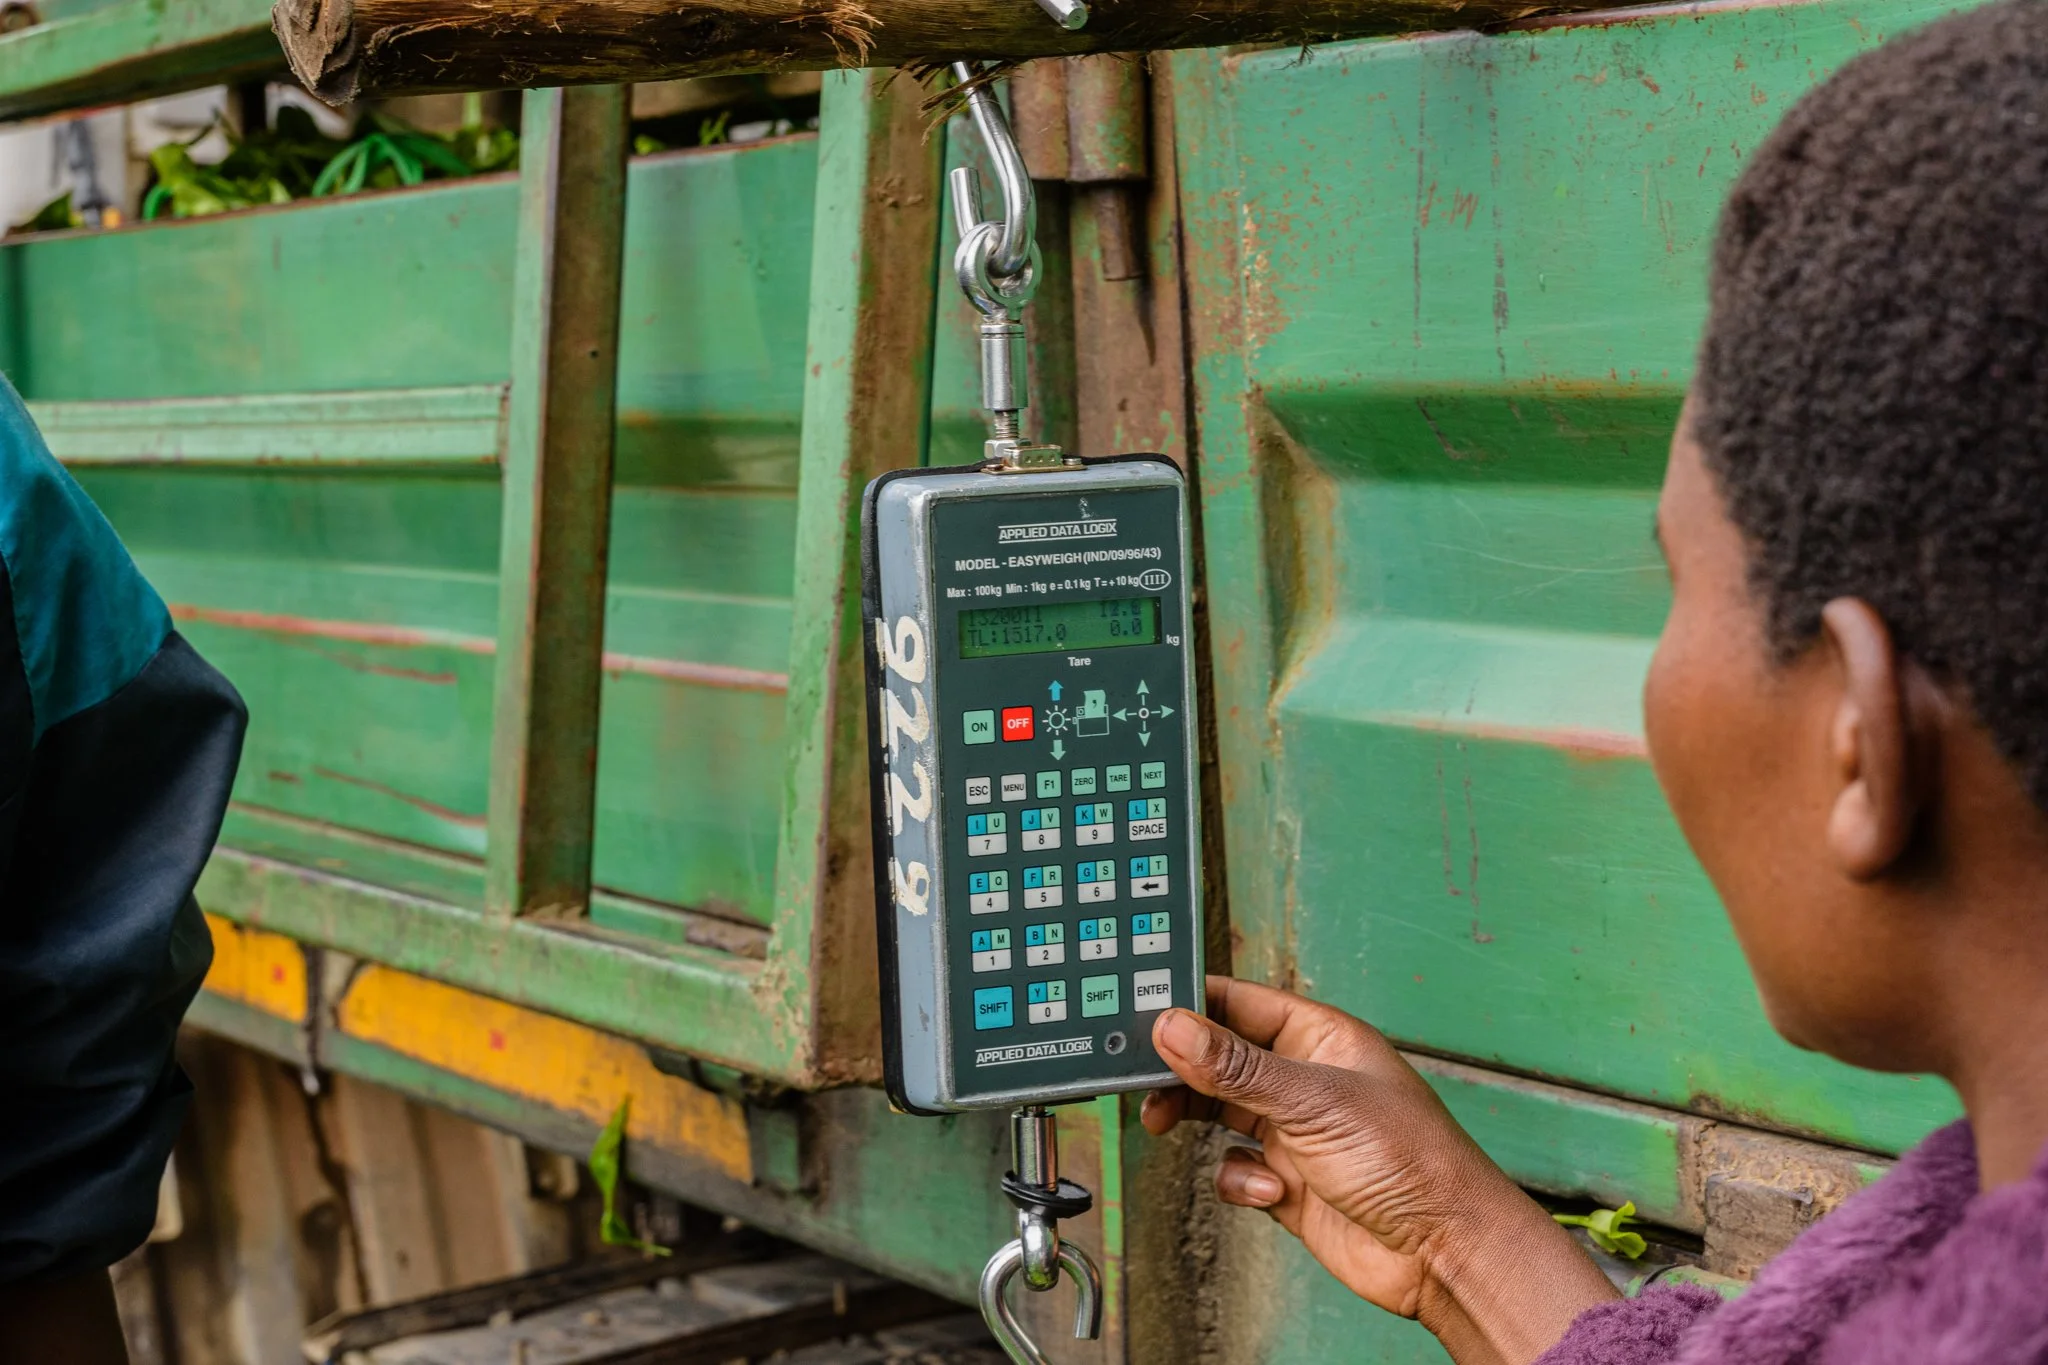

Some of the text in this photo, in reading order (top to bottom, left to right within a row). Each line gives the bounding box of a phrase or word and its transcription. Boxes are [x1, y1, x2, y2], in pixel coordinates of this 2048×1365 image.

[1000, 522, 1117, 540] APPLIED DATA LOGIX
[955, 557, 1000, 571] MODEL
[1008, 552, 1082, 568] EASYWEIGH
[975, 585, 1002, 599] 100kg
[1110, 618, 1142, 636] 0.0
[1166, 634, 1180, 646] kg
[1068, 656, 1091, 667] Tare
[971, 722, 988, 732] ON
[1007, 717, 1030, 729] OFF
[1109, 774, 1128, 783] TARE
[1144, 771, 1162, 780] NEXT
[1044, 780, 1055, 790] F1
[1074, 777, 1094, 786] ZERO
[969, 786, 988, 796] ESC
[1004, 783, 1024, 792] MENU
[1082, 808, 1108, 820] K W
[1135, 803, 1160, 815] L X
[994, 818, 1000, 828] U
[1028, 814, 1054, 825] J V
[1092, 830, 1098, 840] 9
[1132, 823, 1164, 836] SPACE
[984, 839, 990, 850] 7
[1038, 834, 1044, 845] 8
[1083, 866, 1109, 877] G S
[1137, 861, 1162, 872] H T
[976, 877, 1002, 887] E Q
[1030, 871, 1056, 882] F R
[1040, 892, 1046, 902] 5
[1094, 887, 1100, 897] 6
[986, 898, 992, 908] 4
[1085, 923, 1111, 934] C O
[1138, 918, 1164, 929] D P
[978, 934, 1005, 946] A M
[1032, 929, 1058, 940] B N
[1096, 944, 1102, 954] 3
[1043, 950, 1049, 960] 2
[990, 956, 995, 966] 1
[1034, 986, 1060, 997] Y Z
[1137, 984, 1169, 996] ENTER
[1086, 990, 1114, 1002] SHIFT
[980, 1002, 1008, 1015] SHIFT
[1045, 1007, 1051, 1018] 0
[976, 1040, 1093, 1064] APPLIED DATA LOGIX
